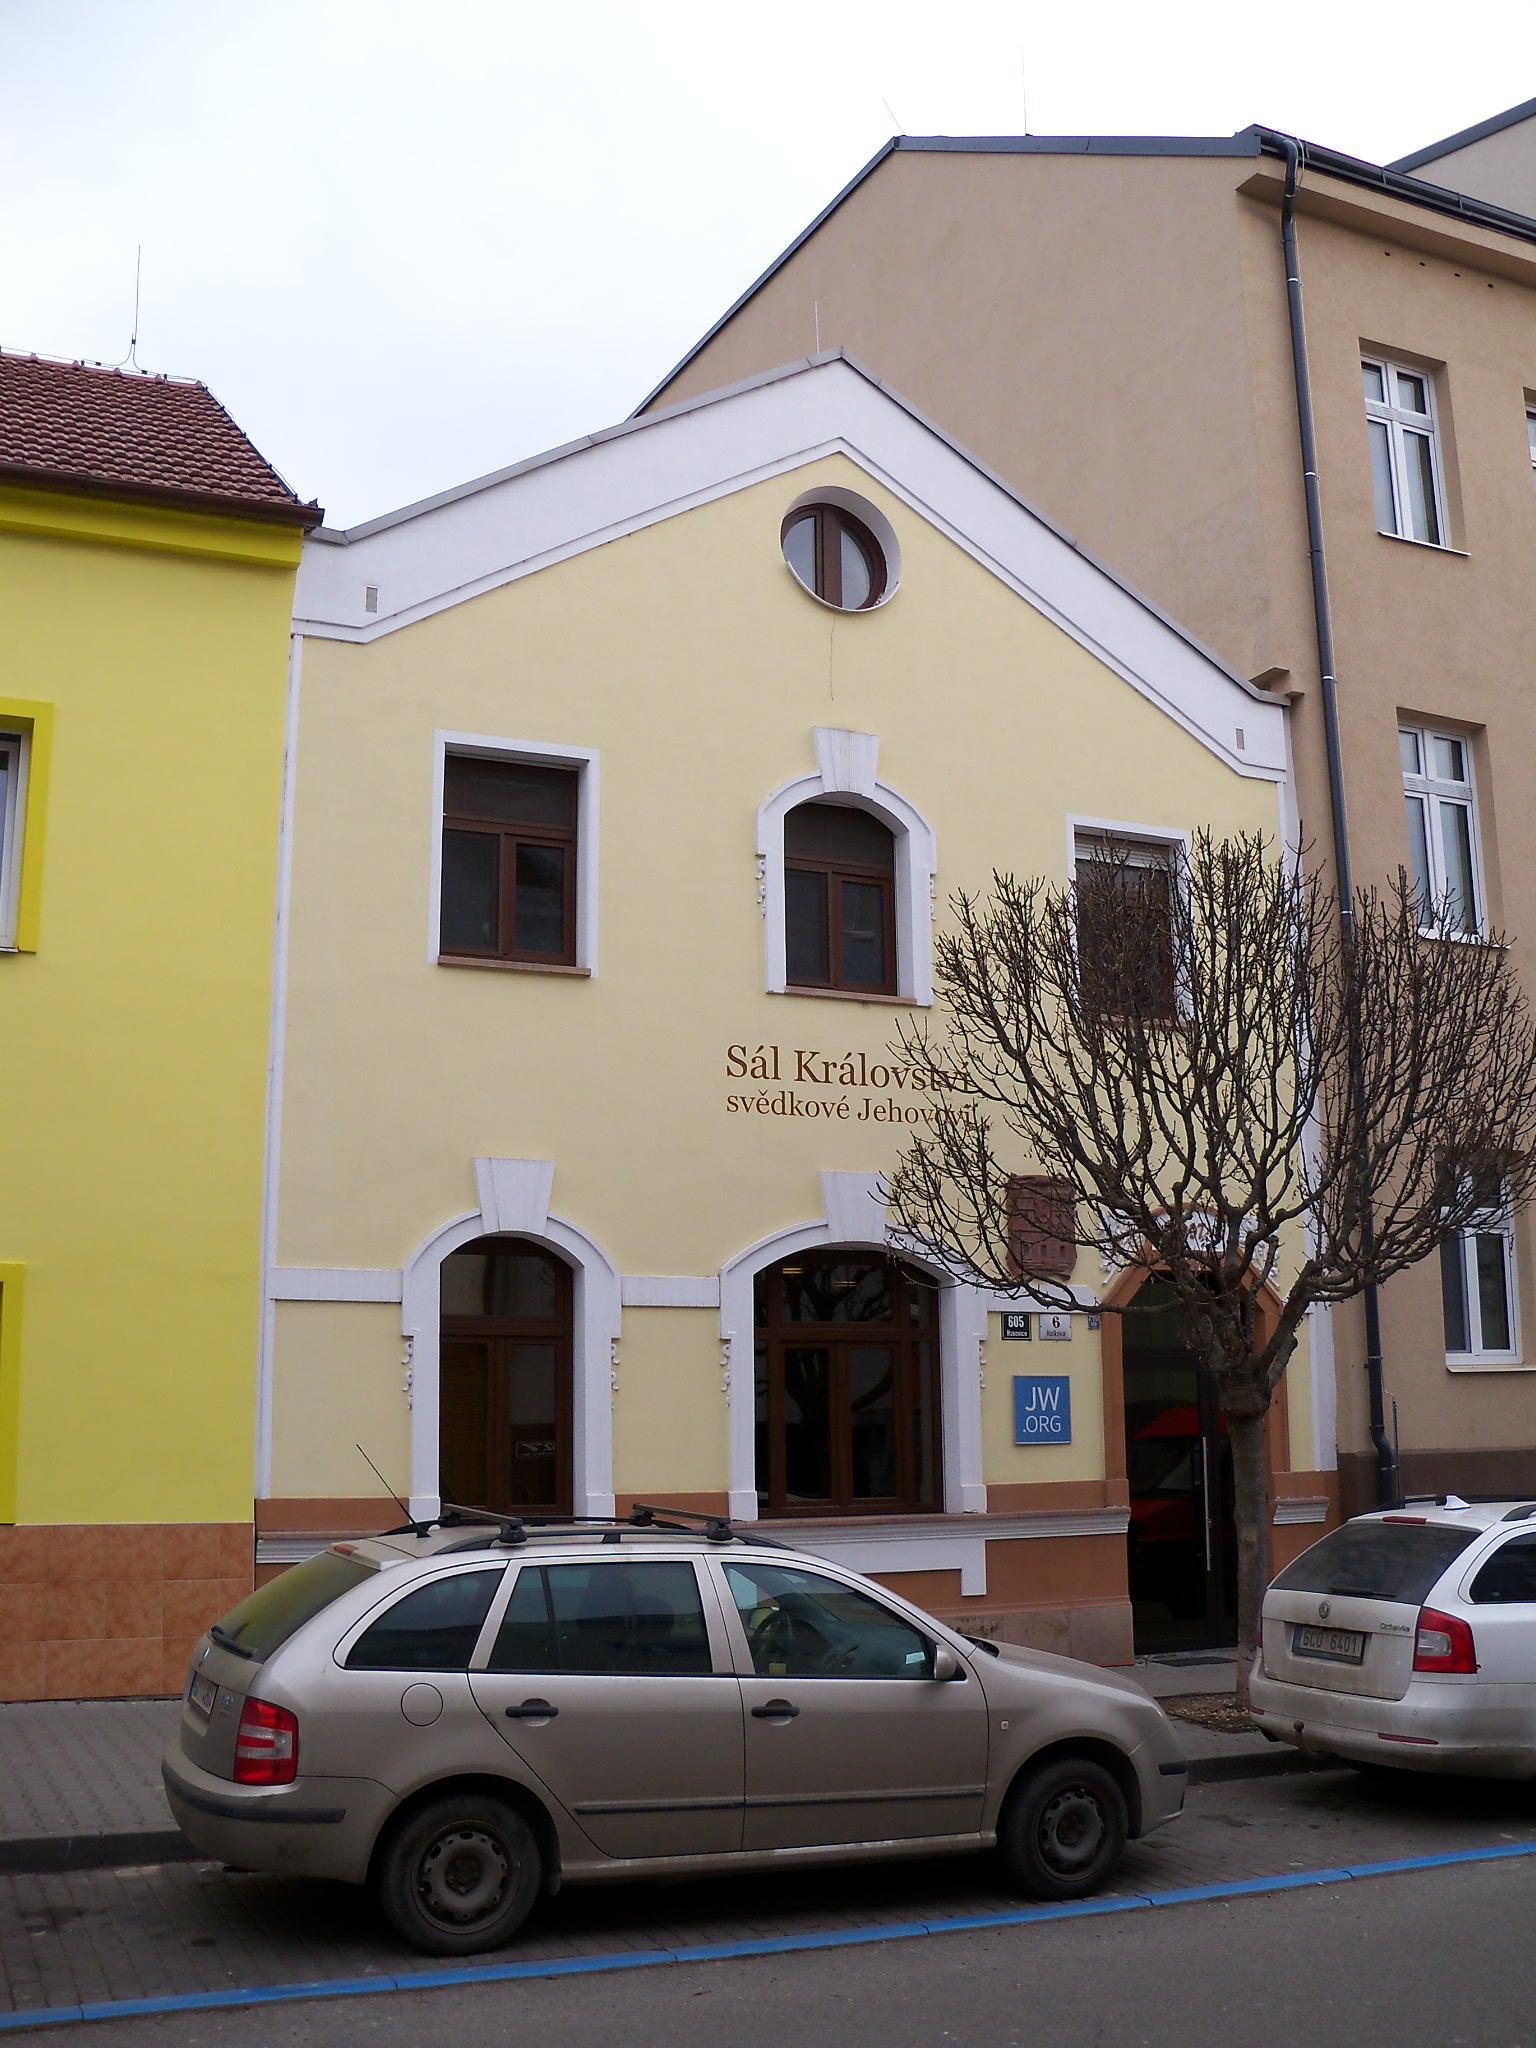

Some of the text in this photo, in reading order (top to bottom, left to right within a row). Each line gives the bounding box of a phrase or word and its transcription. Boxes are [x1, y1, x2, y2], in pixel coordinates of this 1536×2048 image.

[726, 1044, 782, 1081] Sál
[726, 1089, 850, 1120] svědkové
[1008, 1315, 1025, 1328] 605
[1052, 1316, 1061, 1329] 6
[1025, 1386, 1060, 1411] JW
[1023, 1415, 1061, 1433] .ORG
